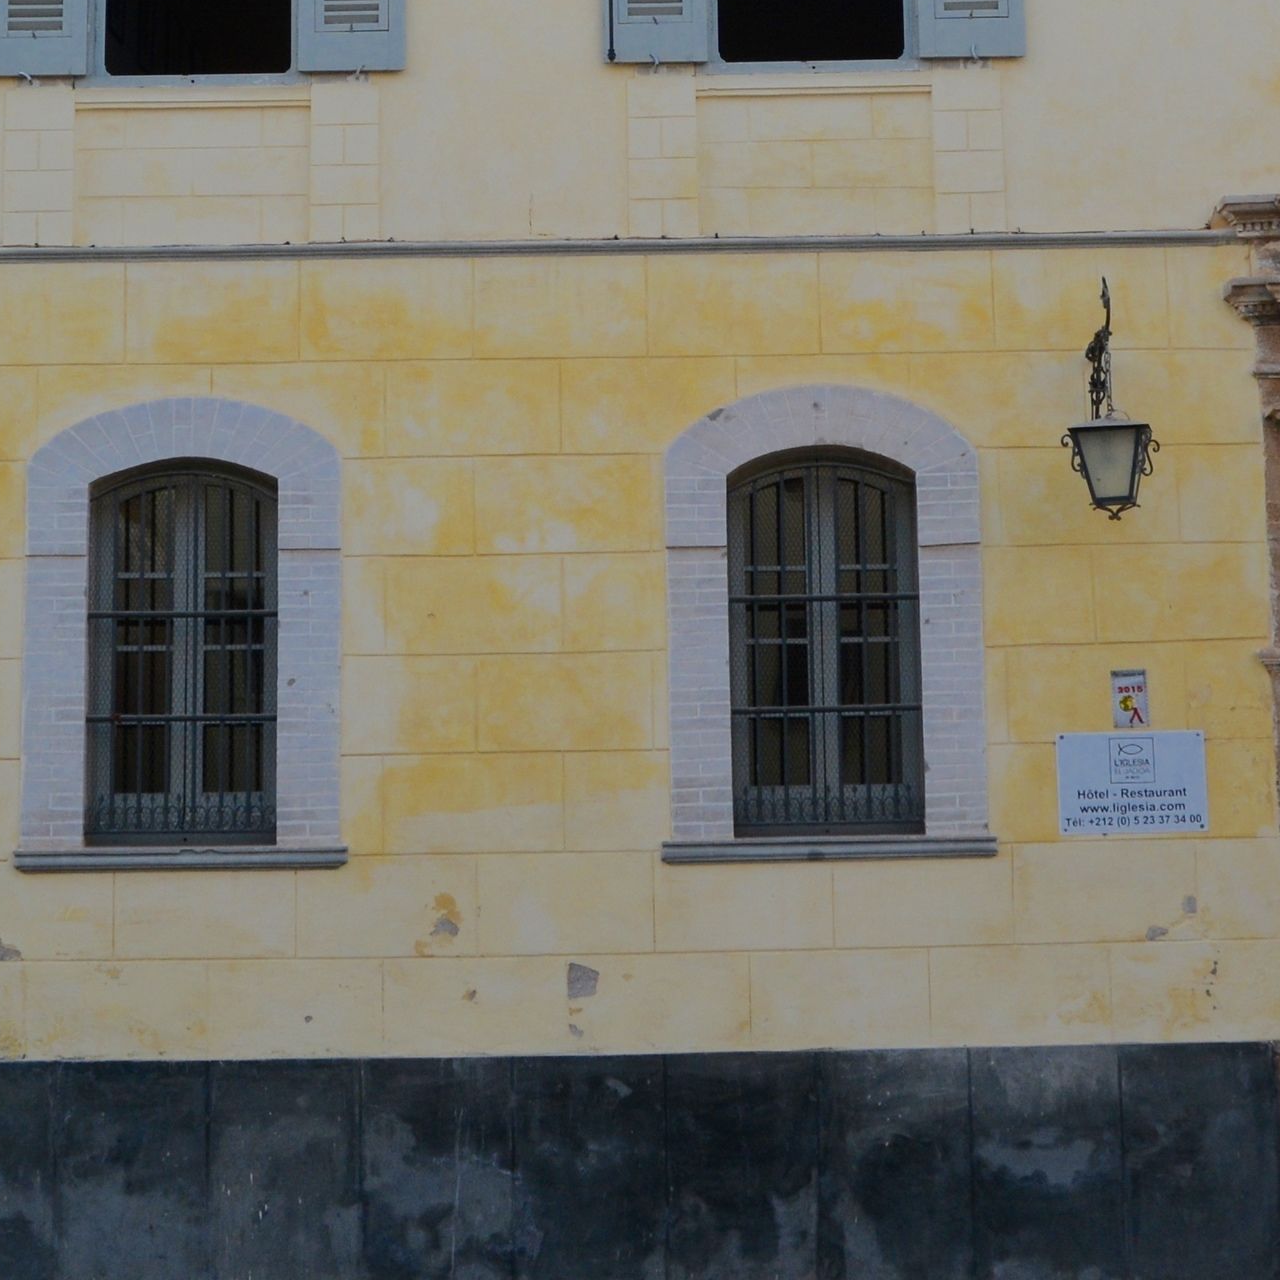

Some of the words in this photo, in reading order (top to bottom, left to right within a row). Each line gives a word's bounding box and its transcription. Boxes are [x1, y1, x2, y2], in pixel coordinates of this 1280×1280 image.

[1117, 685, 1144, 694] 2015
[1077, 789, 1109, 800] Hôtel
[1120, 787, 1187, 799] Restaurant
[1079, 801, 1186, 815] www.liglesia.com
[1066, 817, 1085, 828] Tél:
[1089, 816, 1114, 826] +212
[1117, 816, 1131, 827] (0)
[1134, 815, 1140, 825] 5
[1143, 815, 1156, 825] 23
[1158, 814, 1171, 824] 37
[1174, 814, 1186, 824] 34
[1189, 813, 1202, 823] 00
